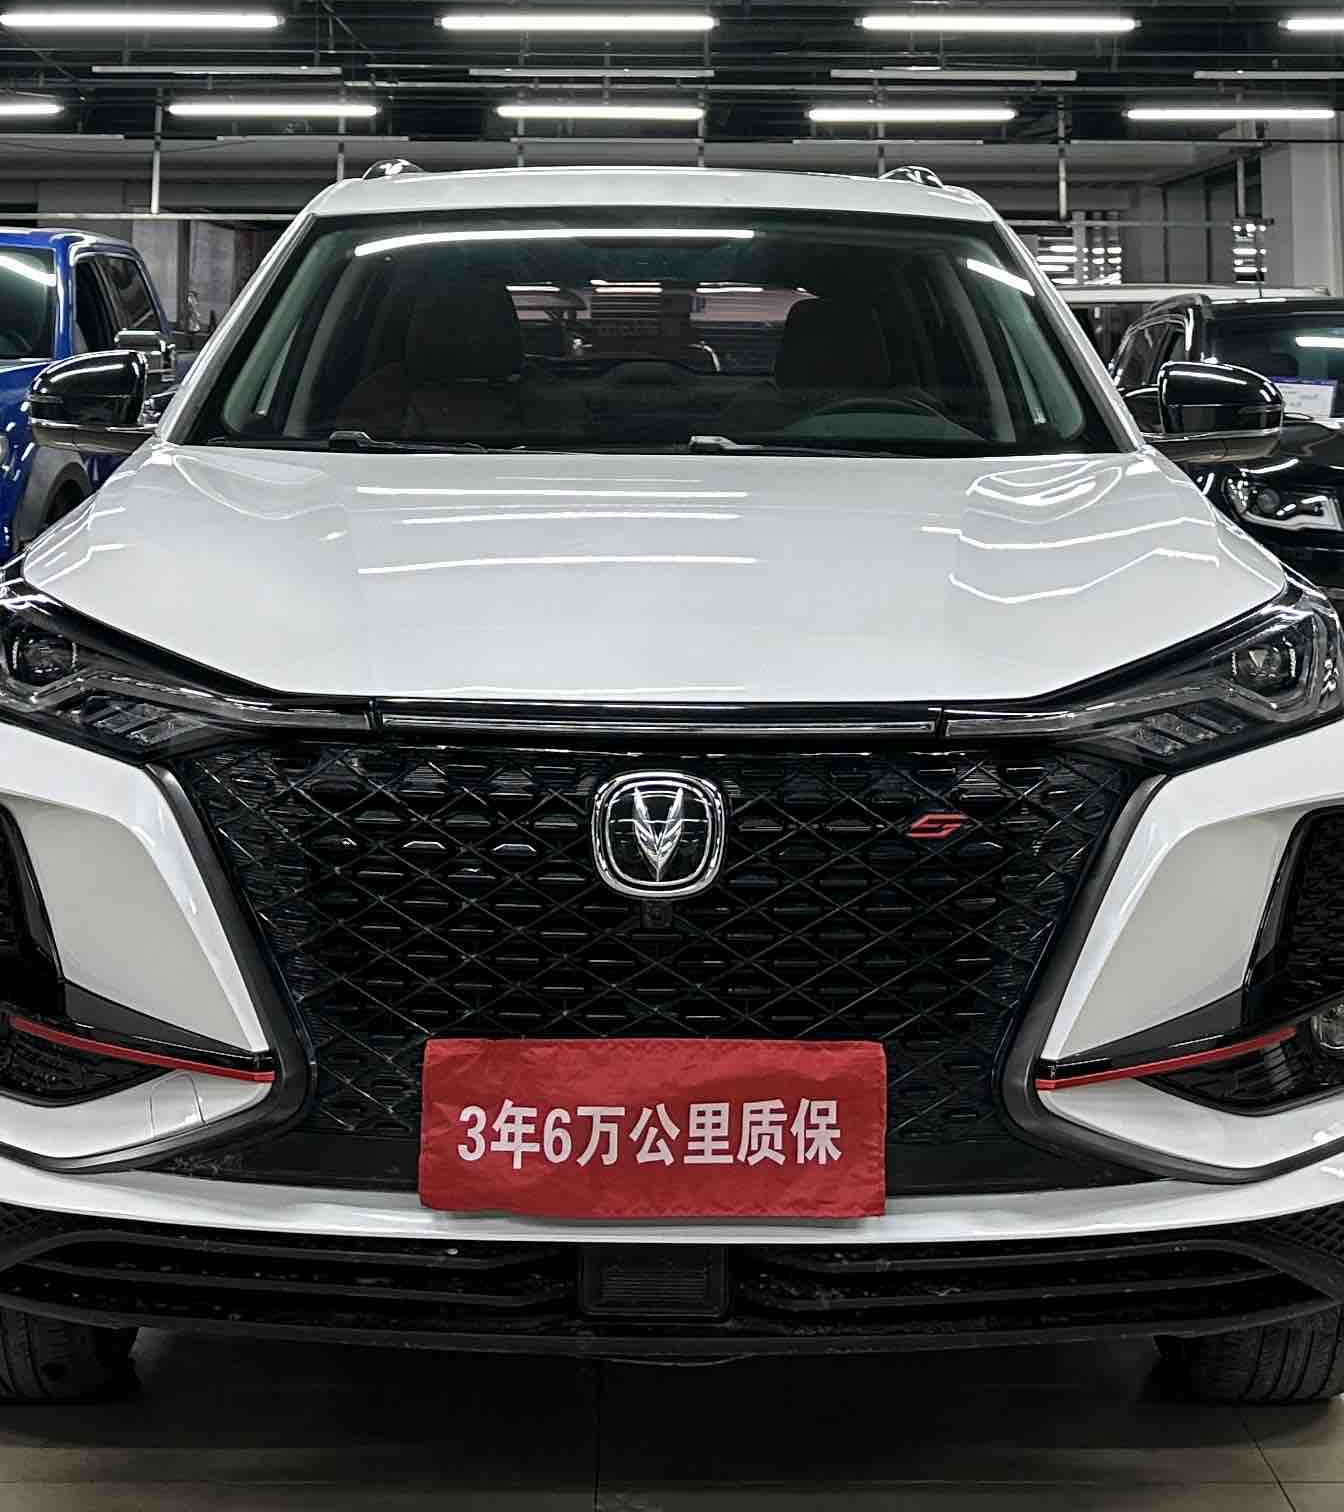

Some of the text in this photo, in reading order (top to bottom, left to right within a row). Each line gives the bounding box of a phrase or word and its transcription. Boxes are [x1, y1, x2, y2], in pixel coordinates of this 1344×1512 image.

[457, 1098, 842, 1169] 3年6万公里质保
